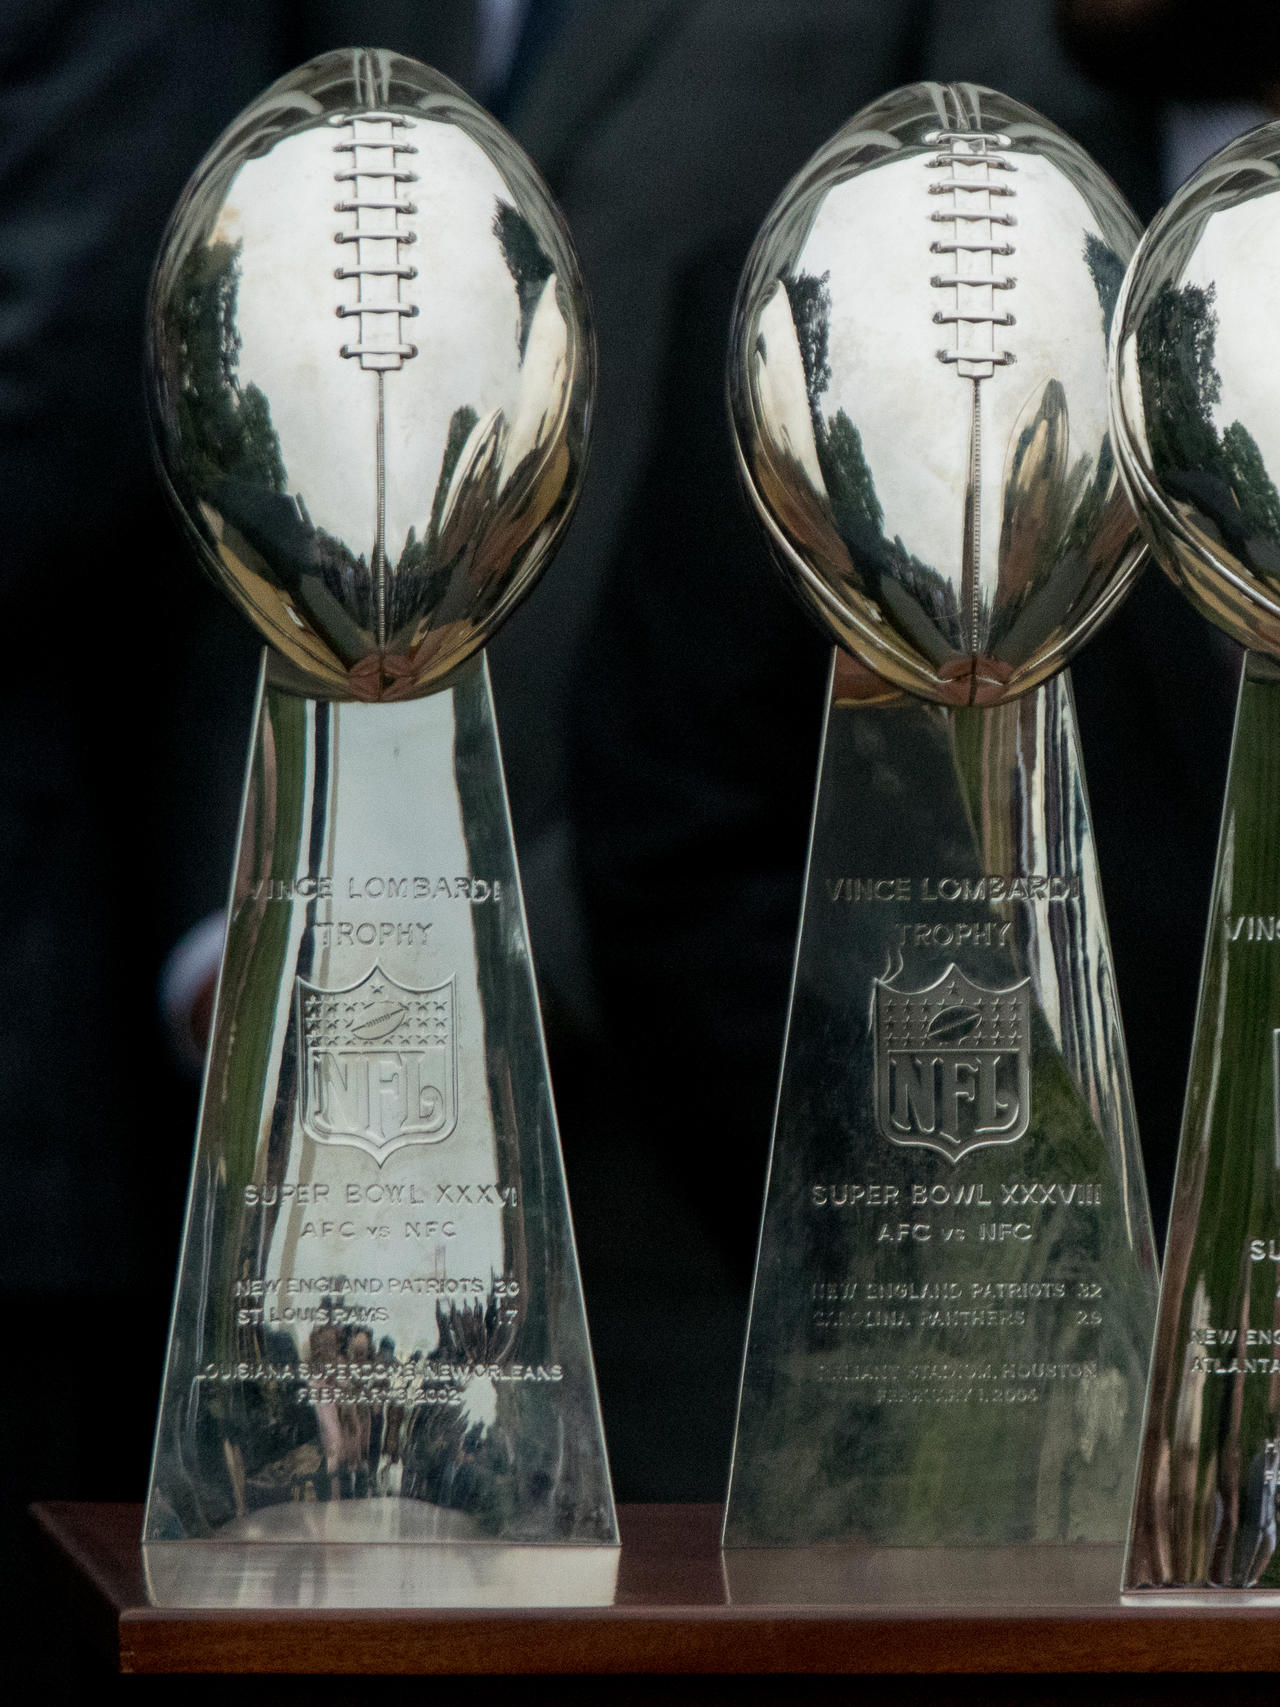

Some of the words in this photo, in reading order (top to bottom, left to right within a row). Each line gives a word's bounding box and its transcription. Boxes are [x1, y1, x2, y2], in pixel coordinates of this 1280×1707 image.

[247, 876, 333, 901] VINCE
[349, 876, 503, 902] LOMBARDI
[826, 877, 912, 901] VINCE
[920, 876, 1081, 901] LOMBARDI
[314, 921, 434, 946] TROPHY
[895, 921, 1012, 946] TROPHY
[311, 1050, 444, 1138] NFL
[889, 1052, 1020, 1143] NFL
[243, 1183, 331, 1206] SUPER
[345, 1183, 425, 1205] BOWL
[435, 1183, 518, 1208] XXXVI
[811, 1184, 899, 1206] SUPER
[911, 1184, 992, 1206] BOWL
[1000, 1184, 1102, 1206] XXXVIII
[300, 1220, 357, 1239] AFC
[404, 1220, 458, 1239] NFC
[877, 1223, 932, 1242] AFC
[978, 1223, 1034, 1242] NFC
[235, 1277, 282, 1297] NEW
[287, 1277, 384, 1297] ENGLAND
[388, 1276, 484, 1296] PATRIOTS
[493, 1280, 521, 1298] 20
[811, 1281, 859, 1300] NEW
[866, 1281, 963, 1300] ENGLAND
[971, 1281, 1065, 1300] PATRIOTS
[269, 1306, 330, 1325] LOUIS
[332, 1306, 390, 1326] RAMS
[1191, 1329, 1237, 1346] NEW
[474, 1363, 564, 1382] ORLEANS
[1002, 1362, 1098, 1380] HOUSTON
